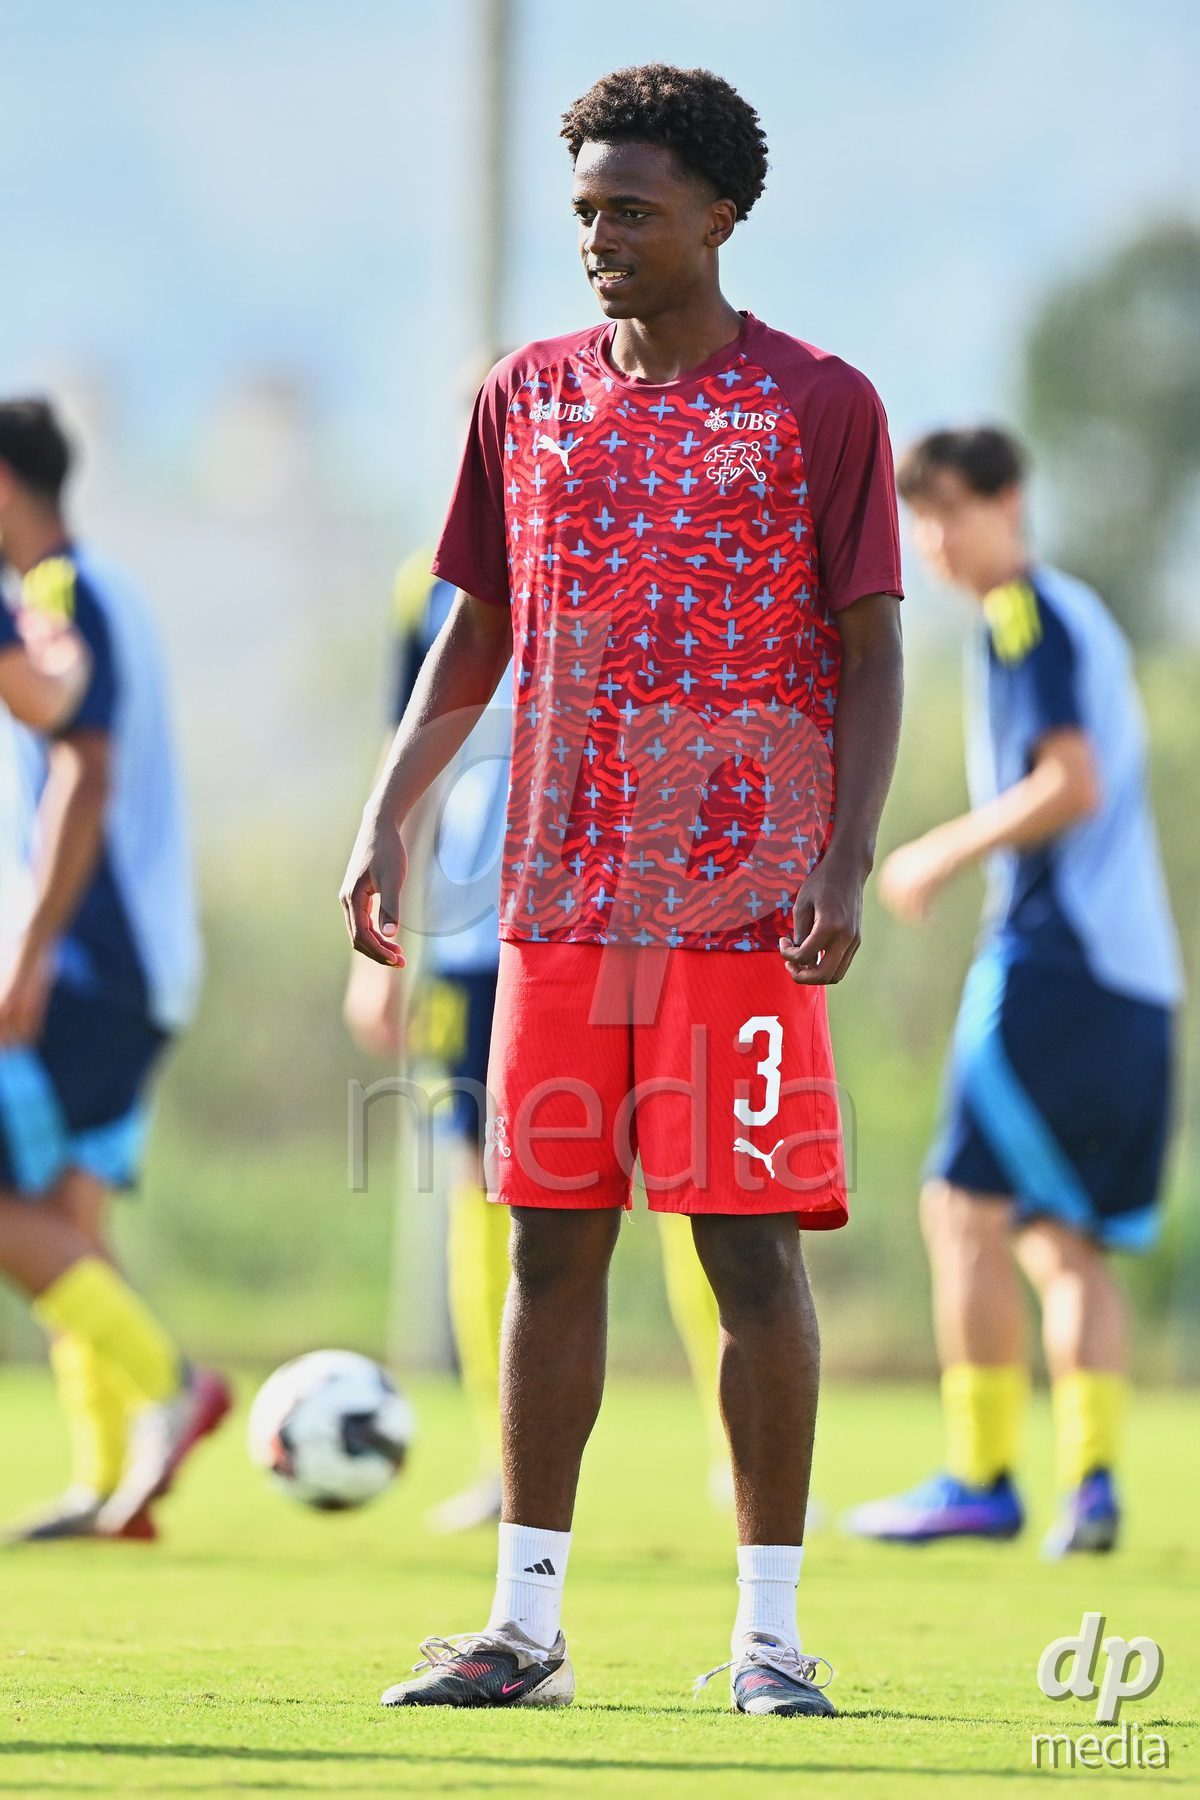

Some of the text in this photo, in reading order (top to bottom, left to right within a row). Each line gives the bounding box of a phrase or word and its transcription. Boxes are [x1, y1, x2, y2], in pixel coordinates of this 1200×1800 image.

[553, 402, 597, 422] UBS
[733, 411, 777, 431] UBS
[733, 1016, 783, 1126] 3
